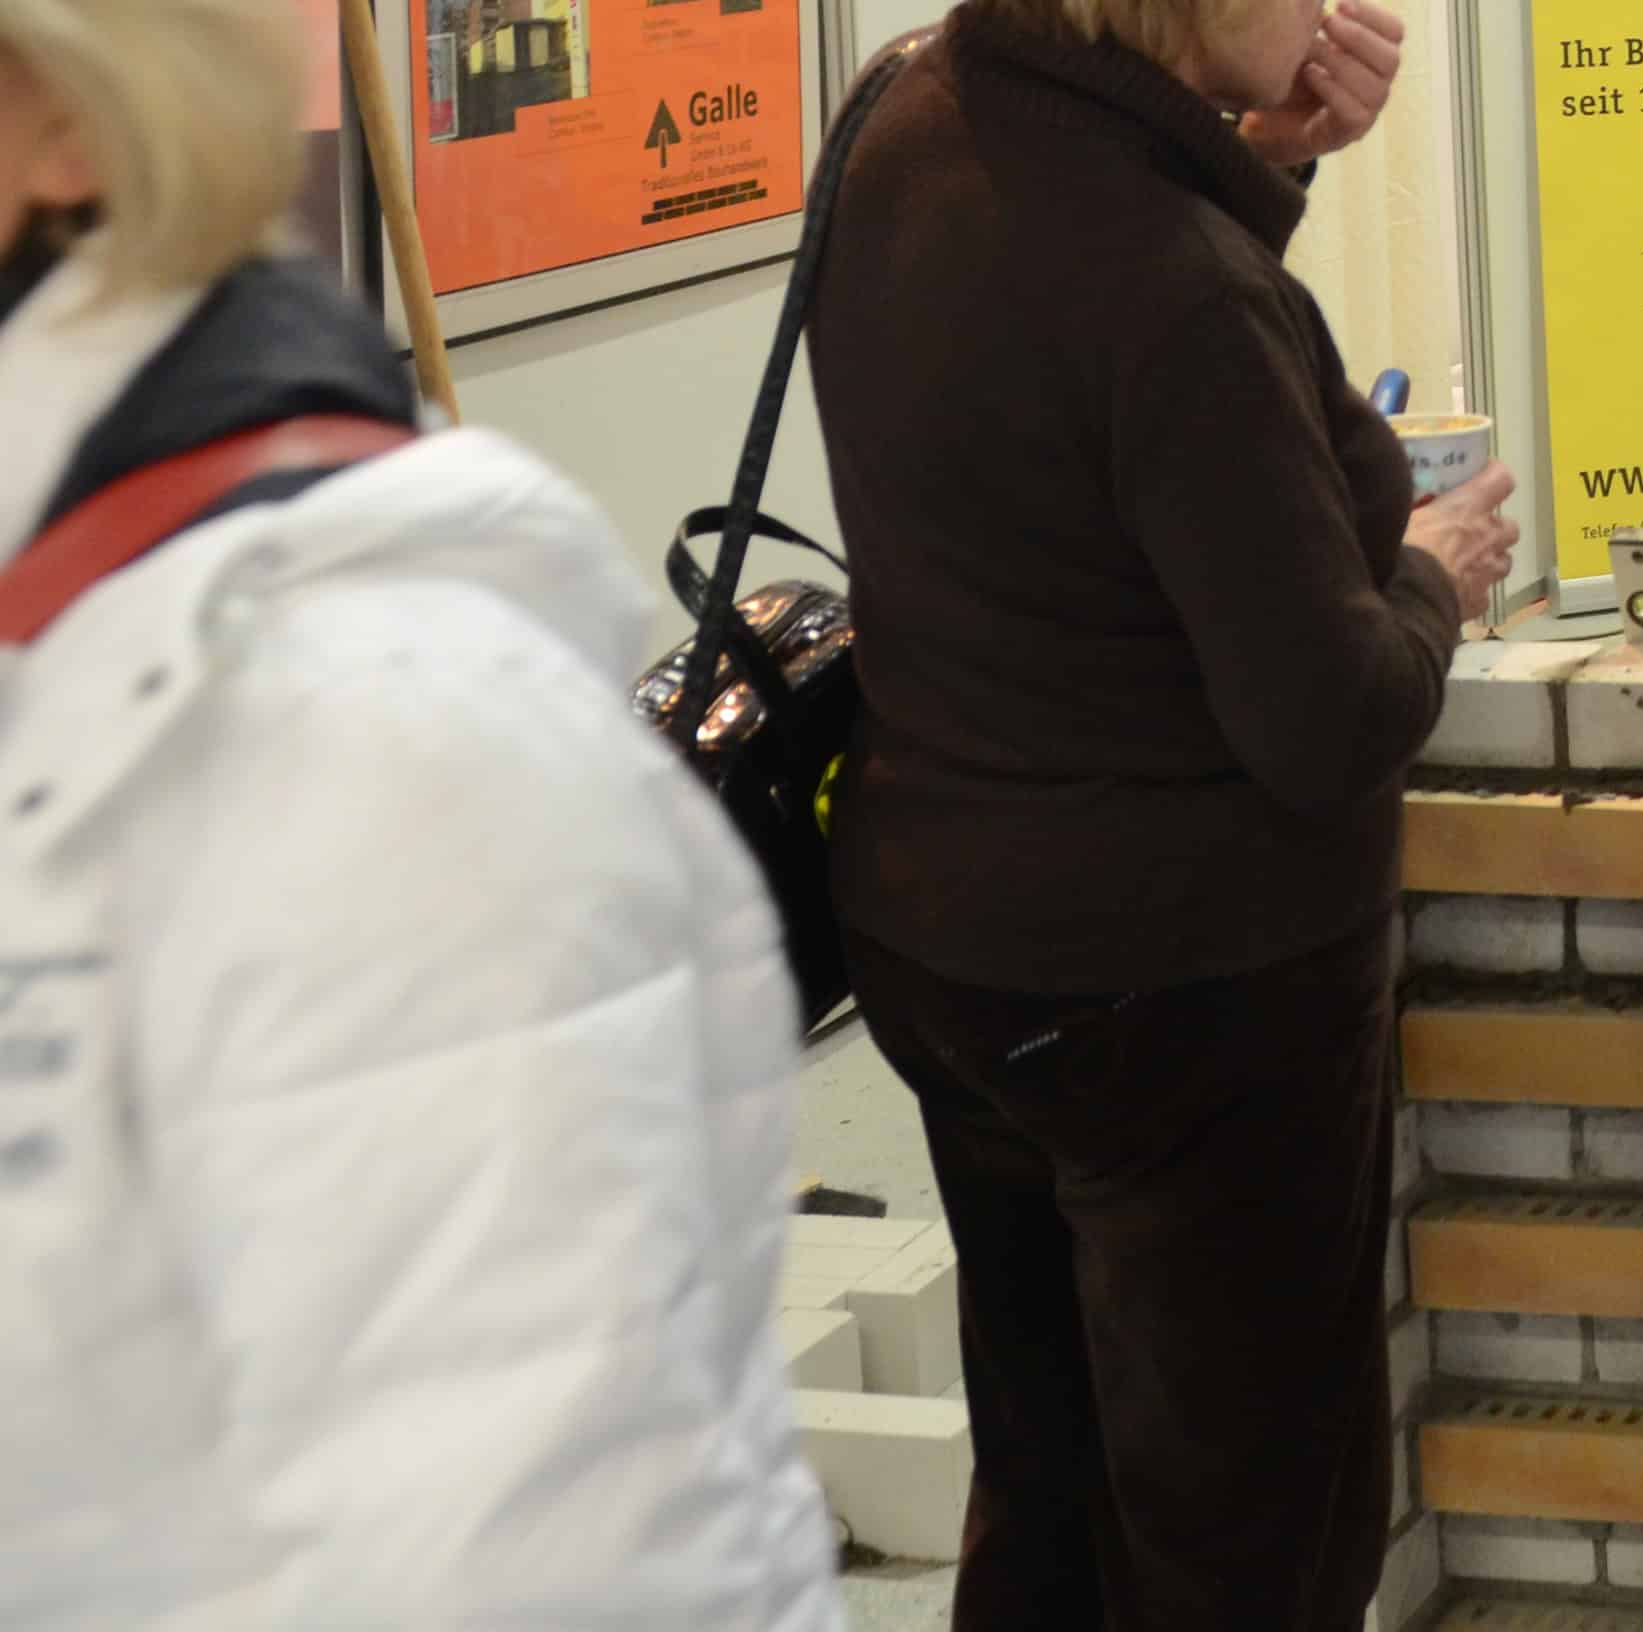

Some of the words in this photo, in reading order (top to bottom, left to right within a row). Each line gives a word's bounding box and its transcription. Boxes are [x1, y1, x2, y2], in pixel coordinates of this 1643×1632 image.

[1560, 39, 1611, 68] Ihr
[689, 83, 757, 126] Galle
[1561, 86, 1625, 117] seit
